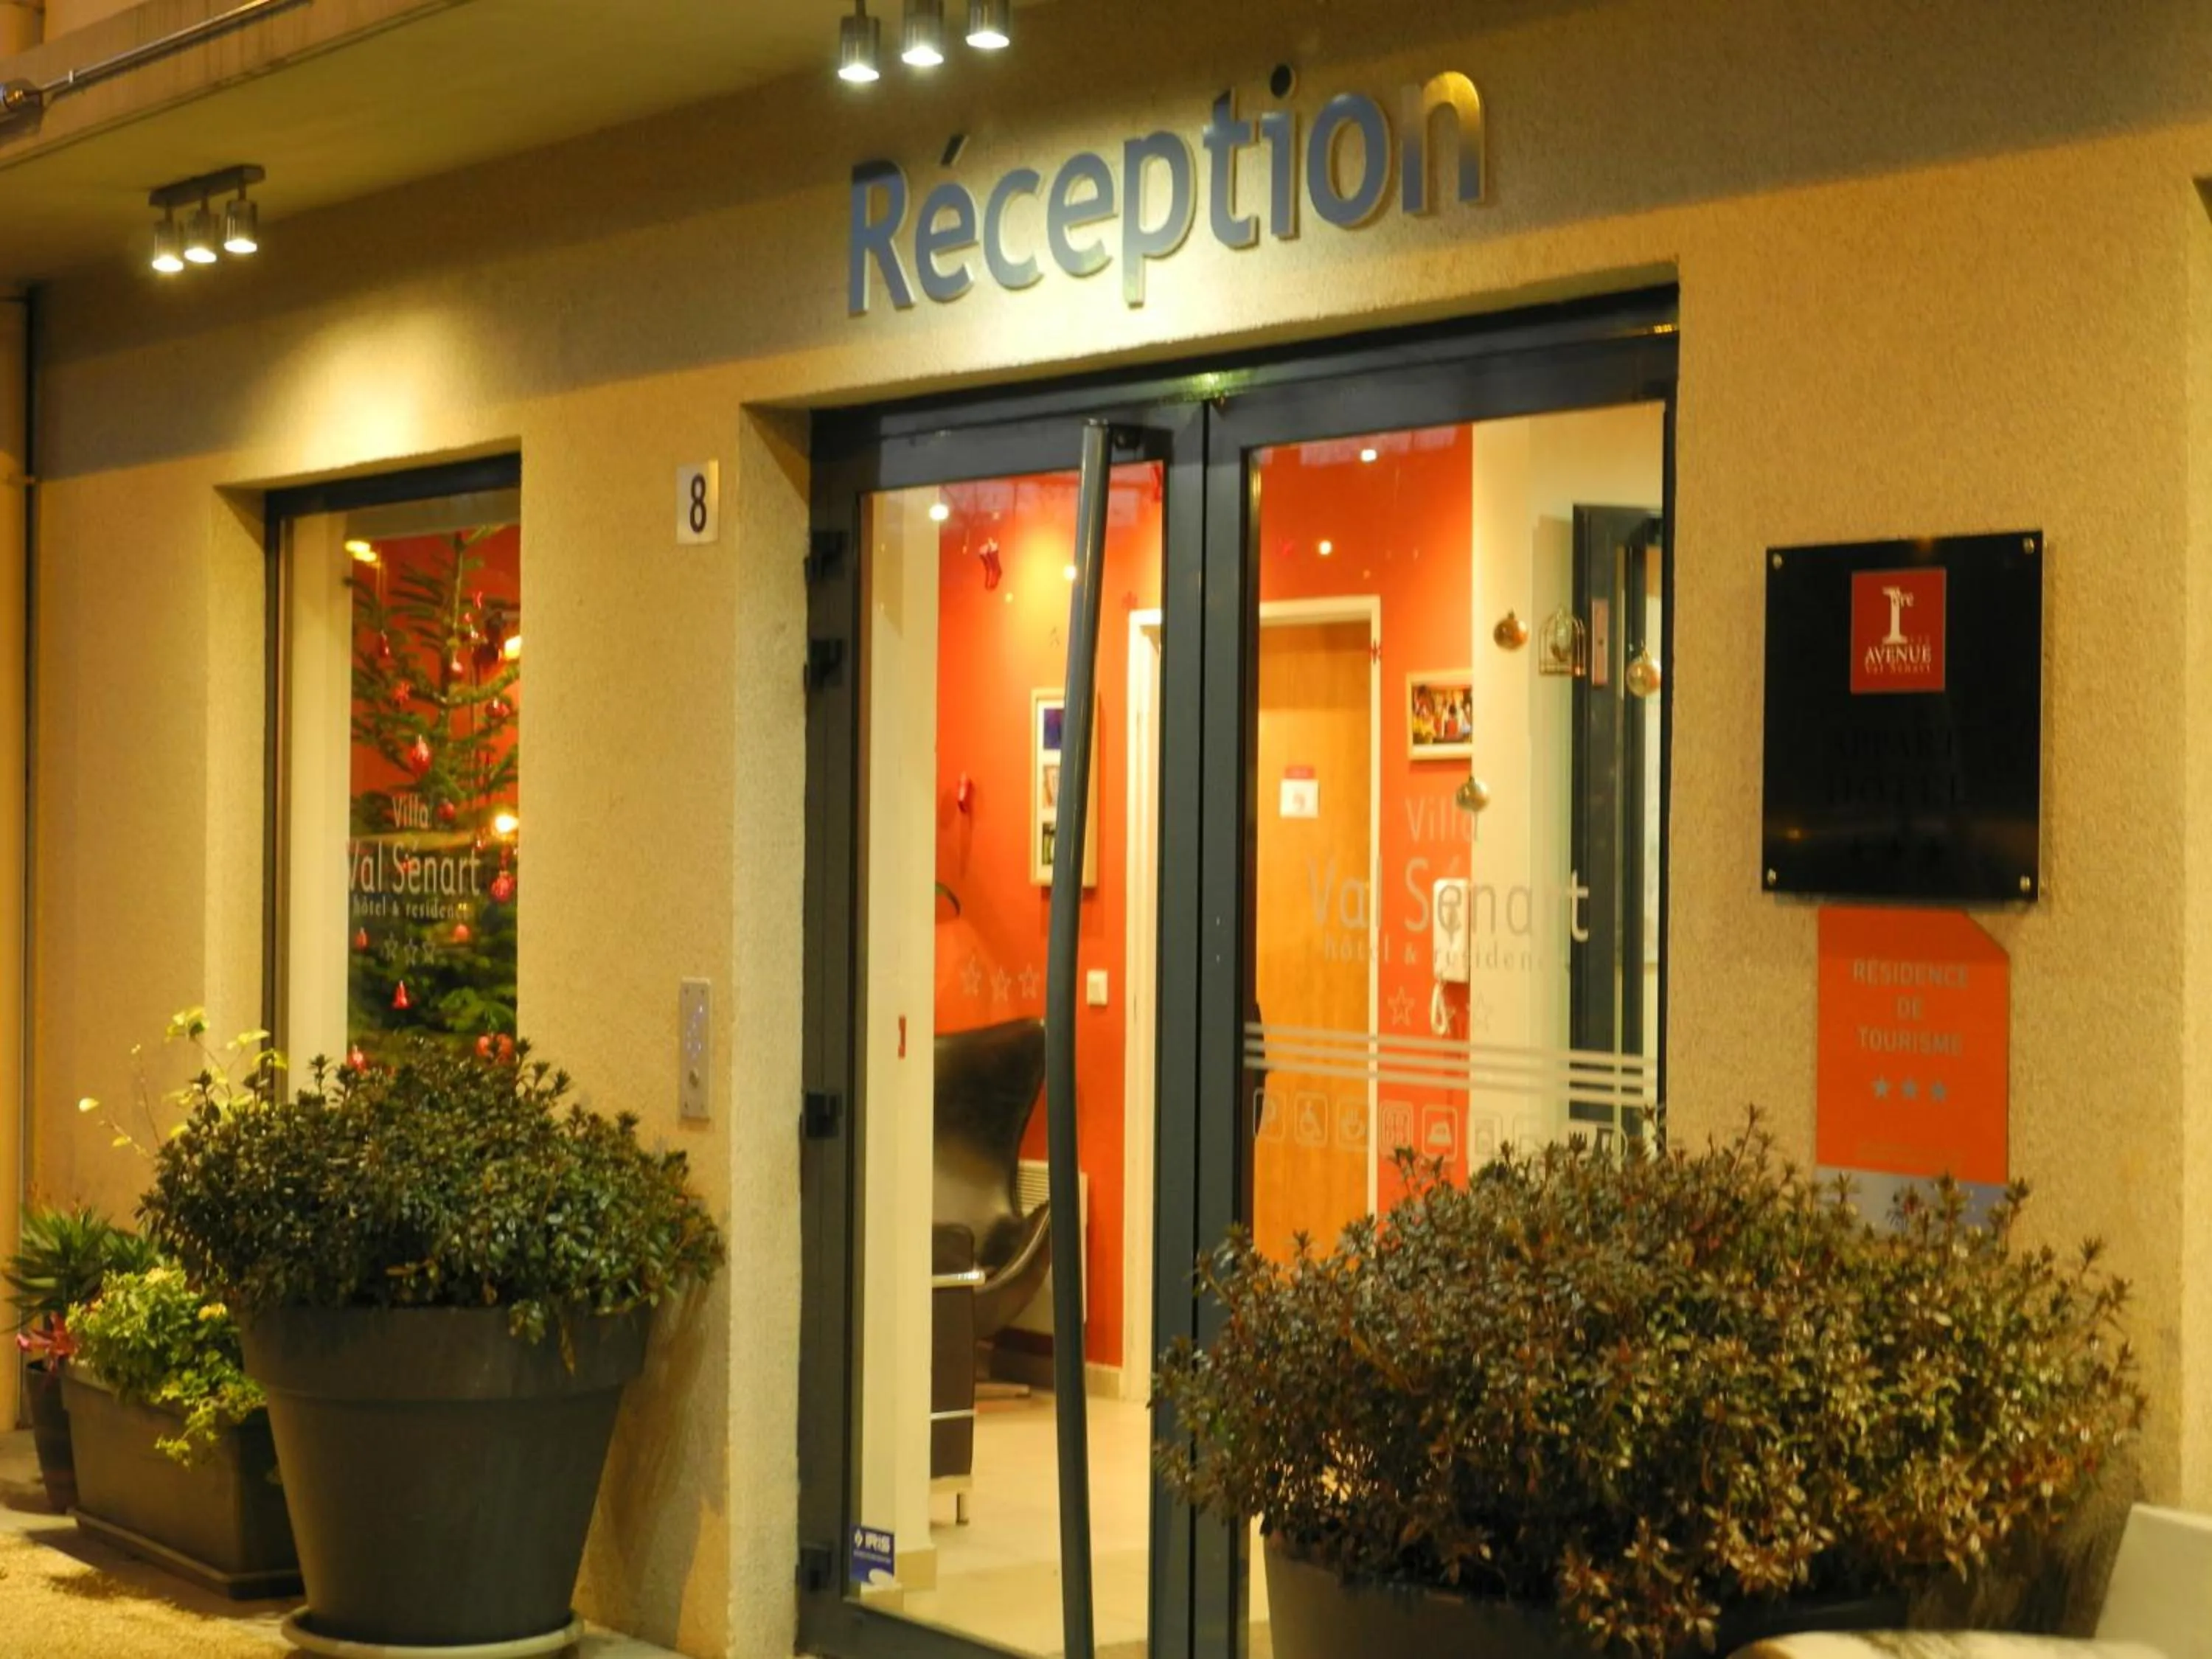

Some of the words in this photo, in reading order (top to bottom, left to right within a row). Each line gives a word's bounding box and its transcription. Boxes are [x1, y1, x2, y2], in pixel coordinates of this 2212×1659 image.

[848, 64, 1484, 316] Réception
[689, 473, 706, 534] 8
[1865, 644, 1931, 666] AVENUE
[392, 793, 429, 829] Villa
[347, 840, 383, 893] Val
[392, 839, 481, 896] Sénart
[1308, 855, 1382, 931] Val
[1404, 854, 1589, 942] Sénat
[1897, 995, 1924, 1020] DE
[1857, 1026, 1963, 1057] TOURISME
